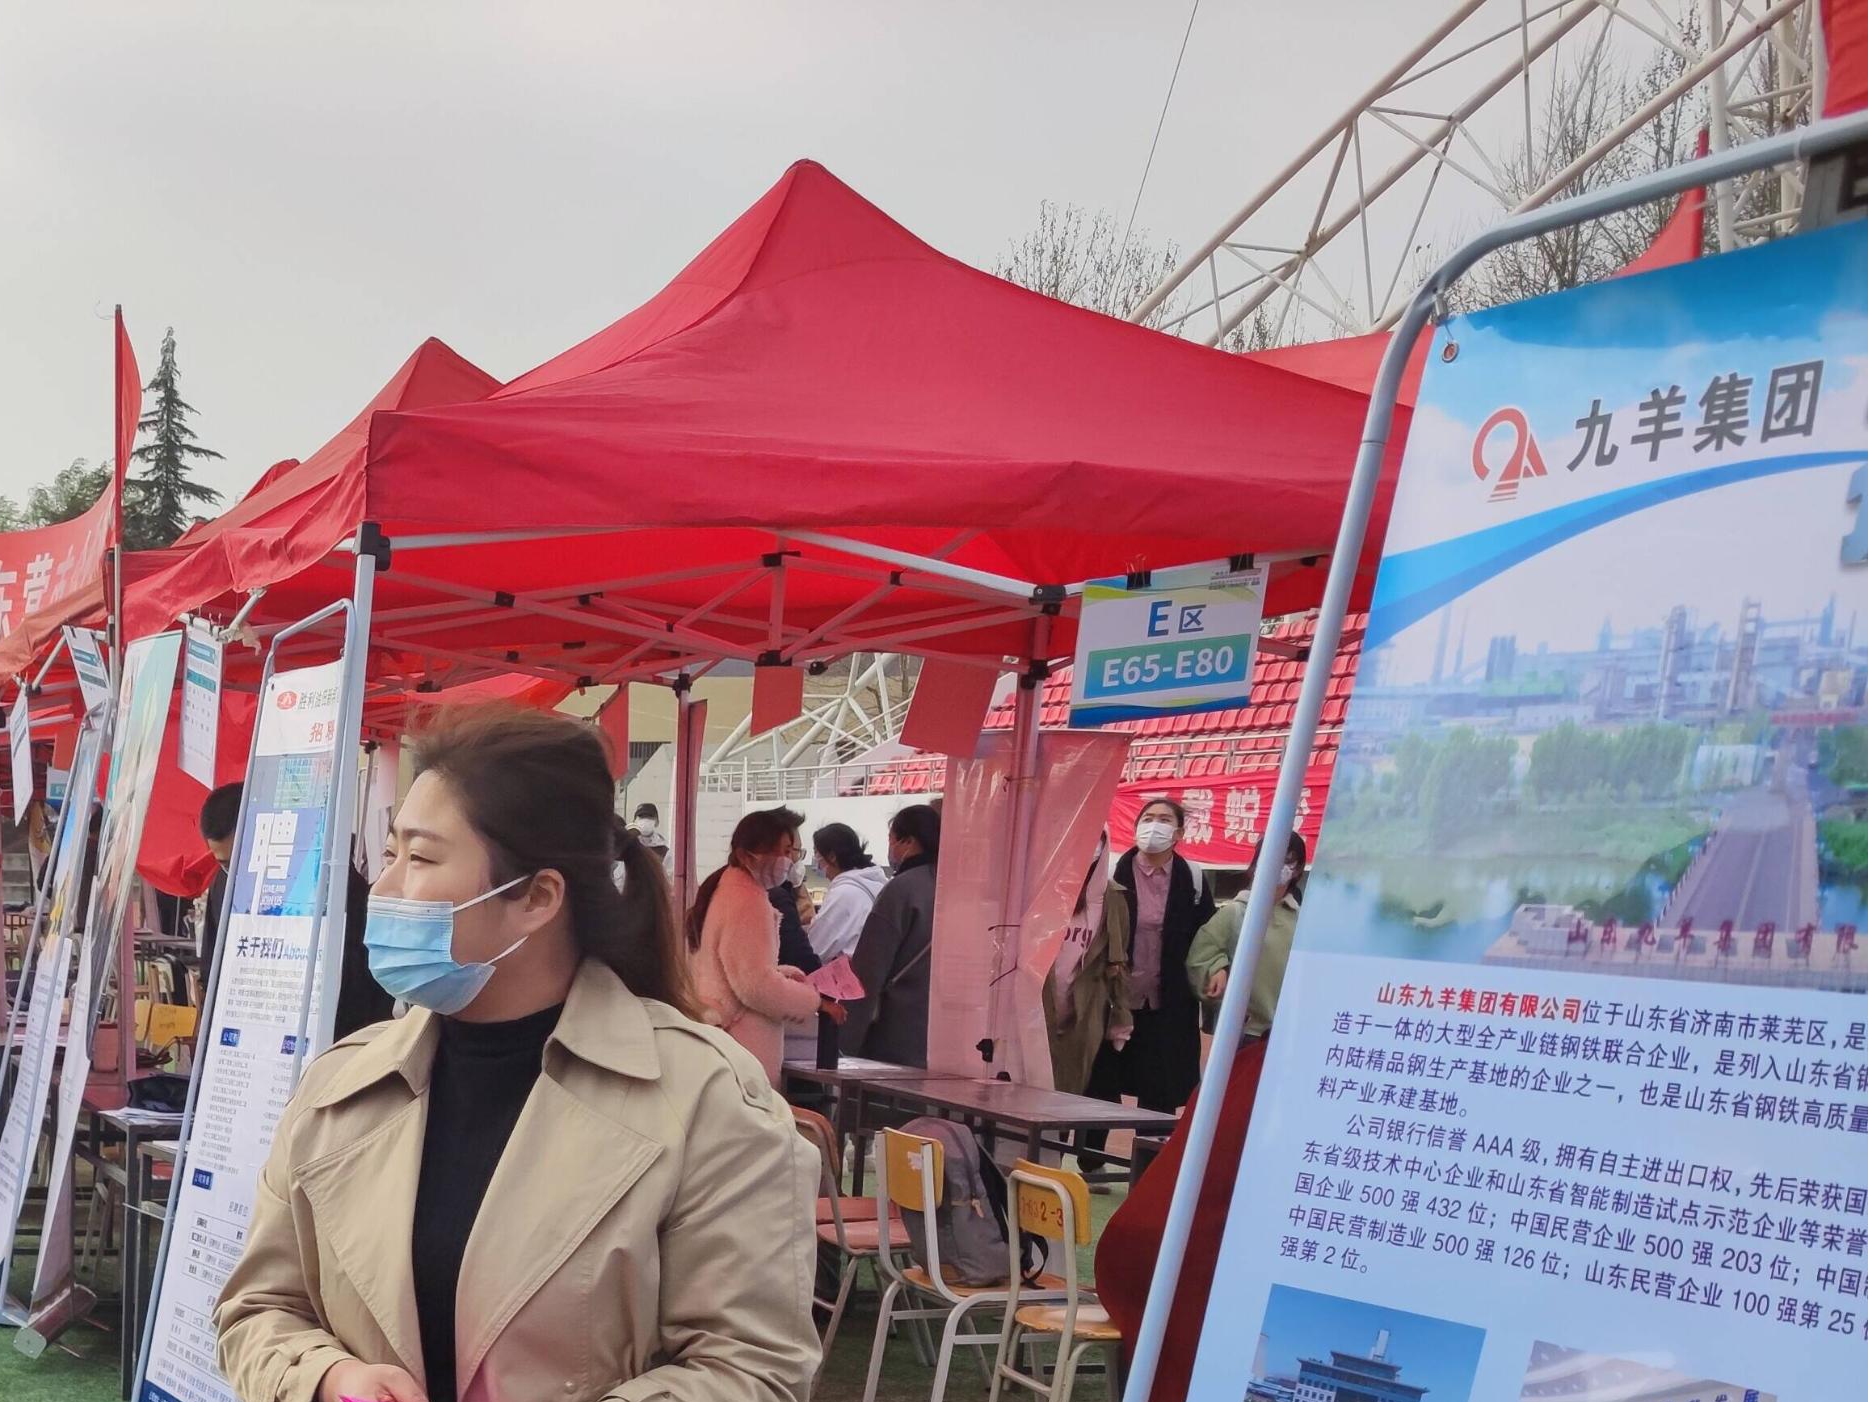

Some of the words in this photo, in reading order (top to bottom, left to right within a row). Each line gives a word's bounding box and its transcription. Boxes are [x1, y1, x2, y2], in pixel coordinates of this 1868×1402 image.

[1566, 359, 1825, 472] 九羊集团
[1102, 645, 1234, 688] E65-E80
[236, 935, 284, 960] 关于我们
[1317, 1075, 1467, 1118] 料产业承建基地。
